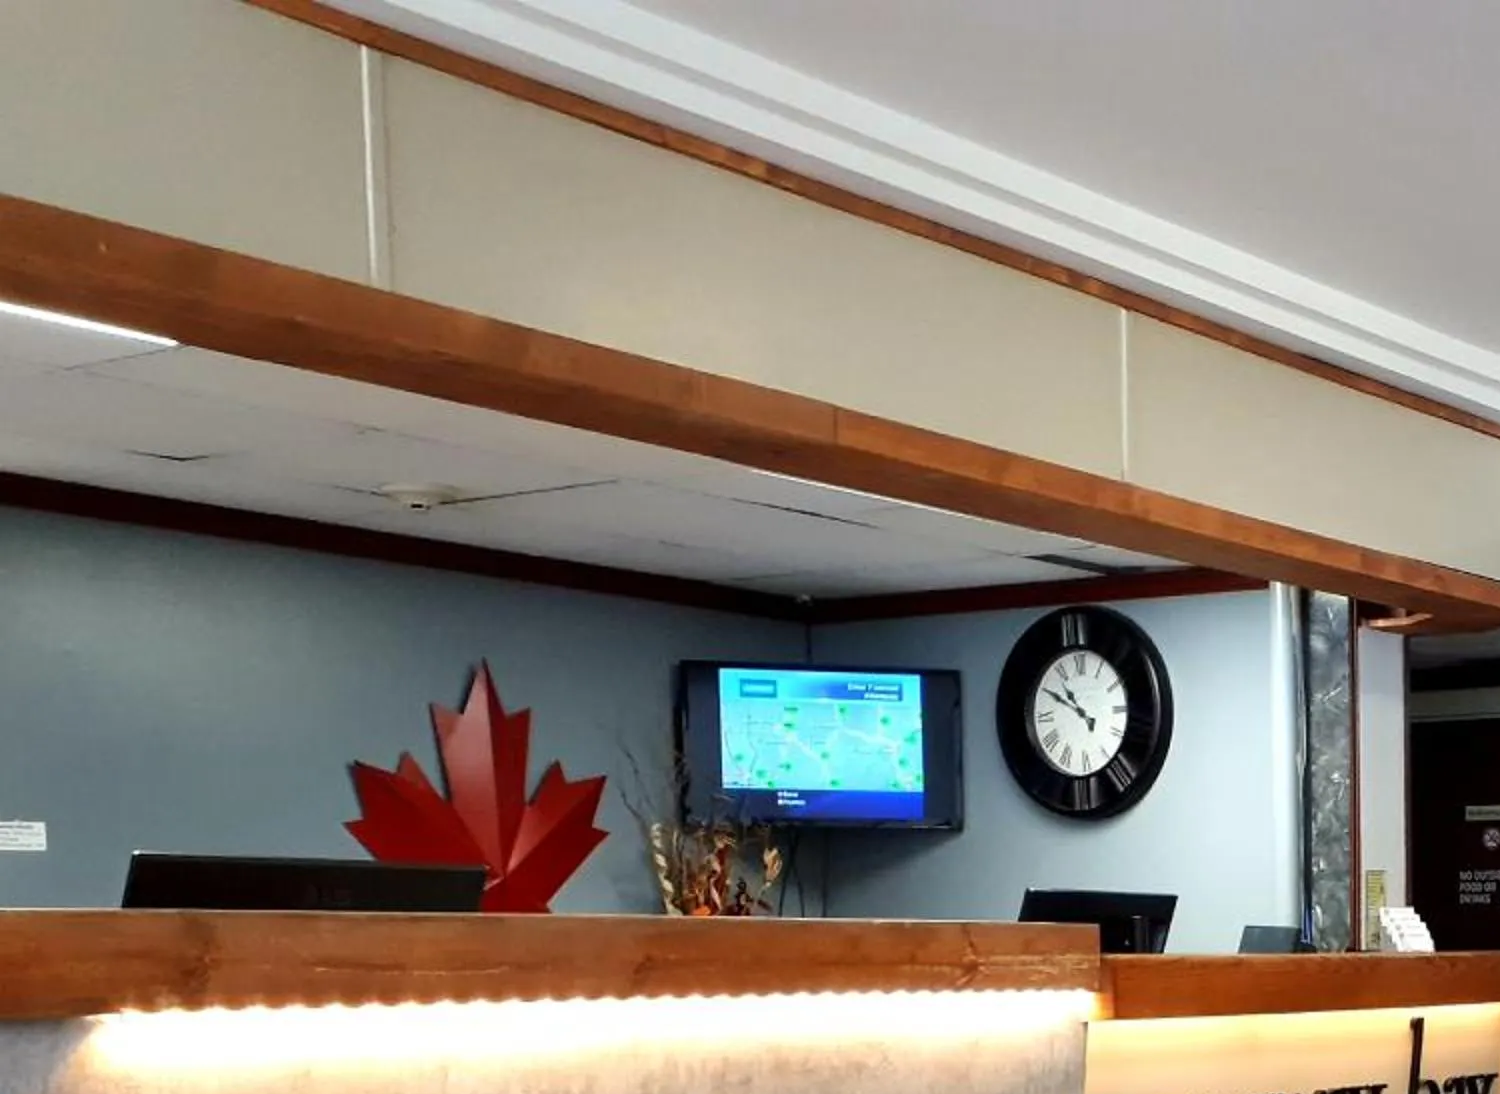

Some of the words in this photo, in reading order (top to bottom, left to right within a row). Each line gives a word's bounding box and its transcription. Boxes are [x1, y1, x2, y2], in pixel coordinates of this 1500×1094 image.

[1459, 870, 1473, 881] NO
[1459, 881, 1483, 893] FOOD
[1484, 881, 1497, 893] OR
[1459, 893, 1491, 905] DRINKS
